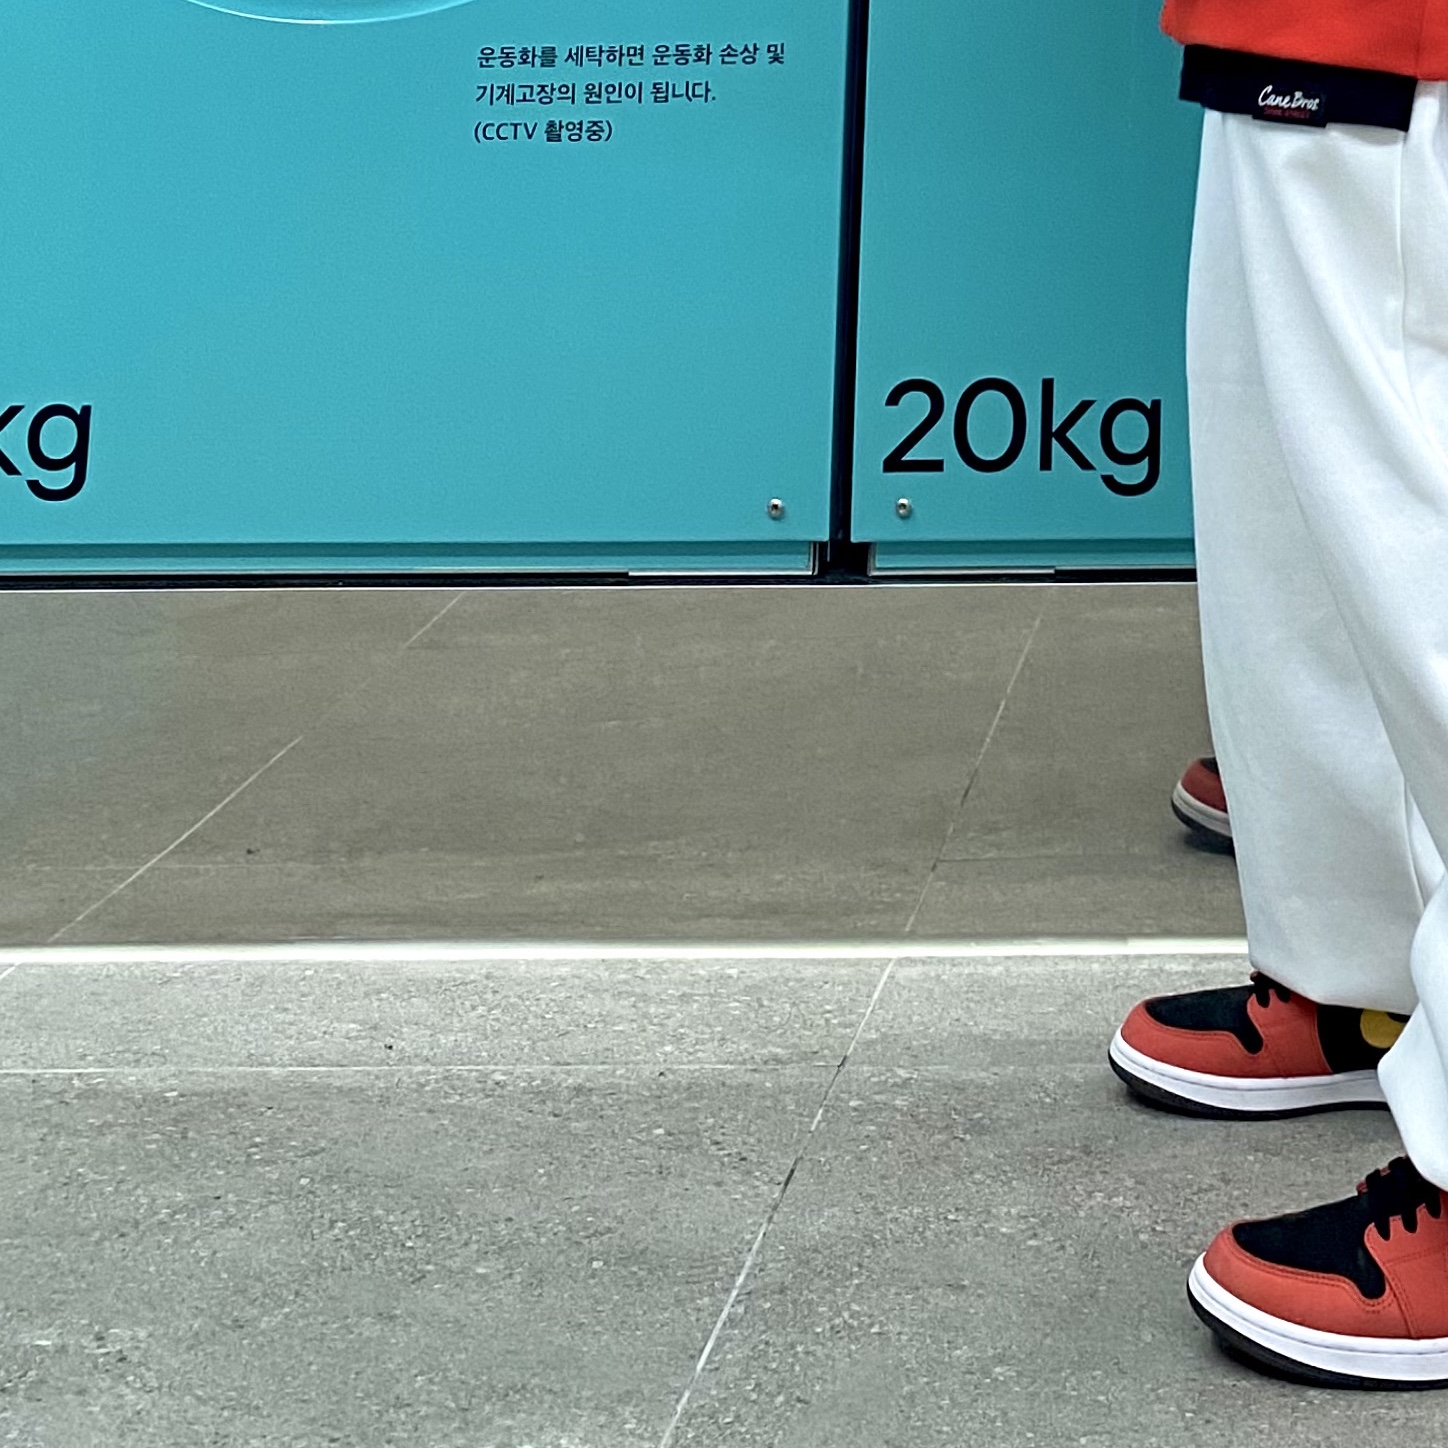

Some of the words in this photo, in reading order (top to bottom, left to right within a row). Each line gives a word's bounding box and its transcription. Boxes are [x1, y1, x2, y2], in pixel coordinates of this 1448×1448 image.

[477, 45, 558, 68] 운동화를
[565, 44, 645, 67] 세탁하면
[652, 43, 712, 66] 운동화
[718, 43, 759, 65] 손상
[766, 42, 785, 64] 및
[475, 82, 576, 105] 기계고장의
[583, 82, 643, 104] 원인이
[650, 81, 716, 103] 됩니다.
[474, 120, 538, 143] (CCTV
[544, 120, 613, 142] 촬영중)
[883, 377, 1163, 495] 20kg
